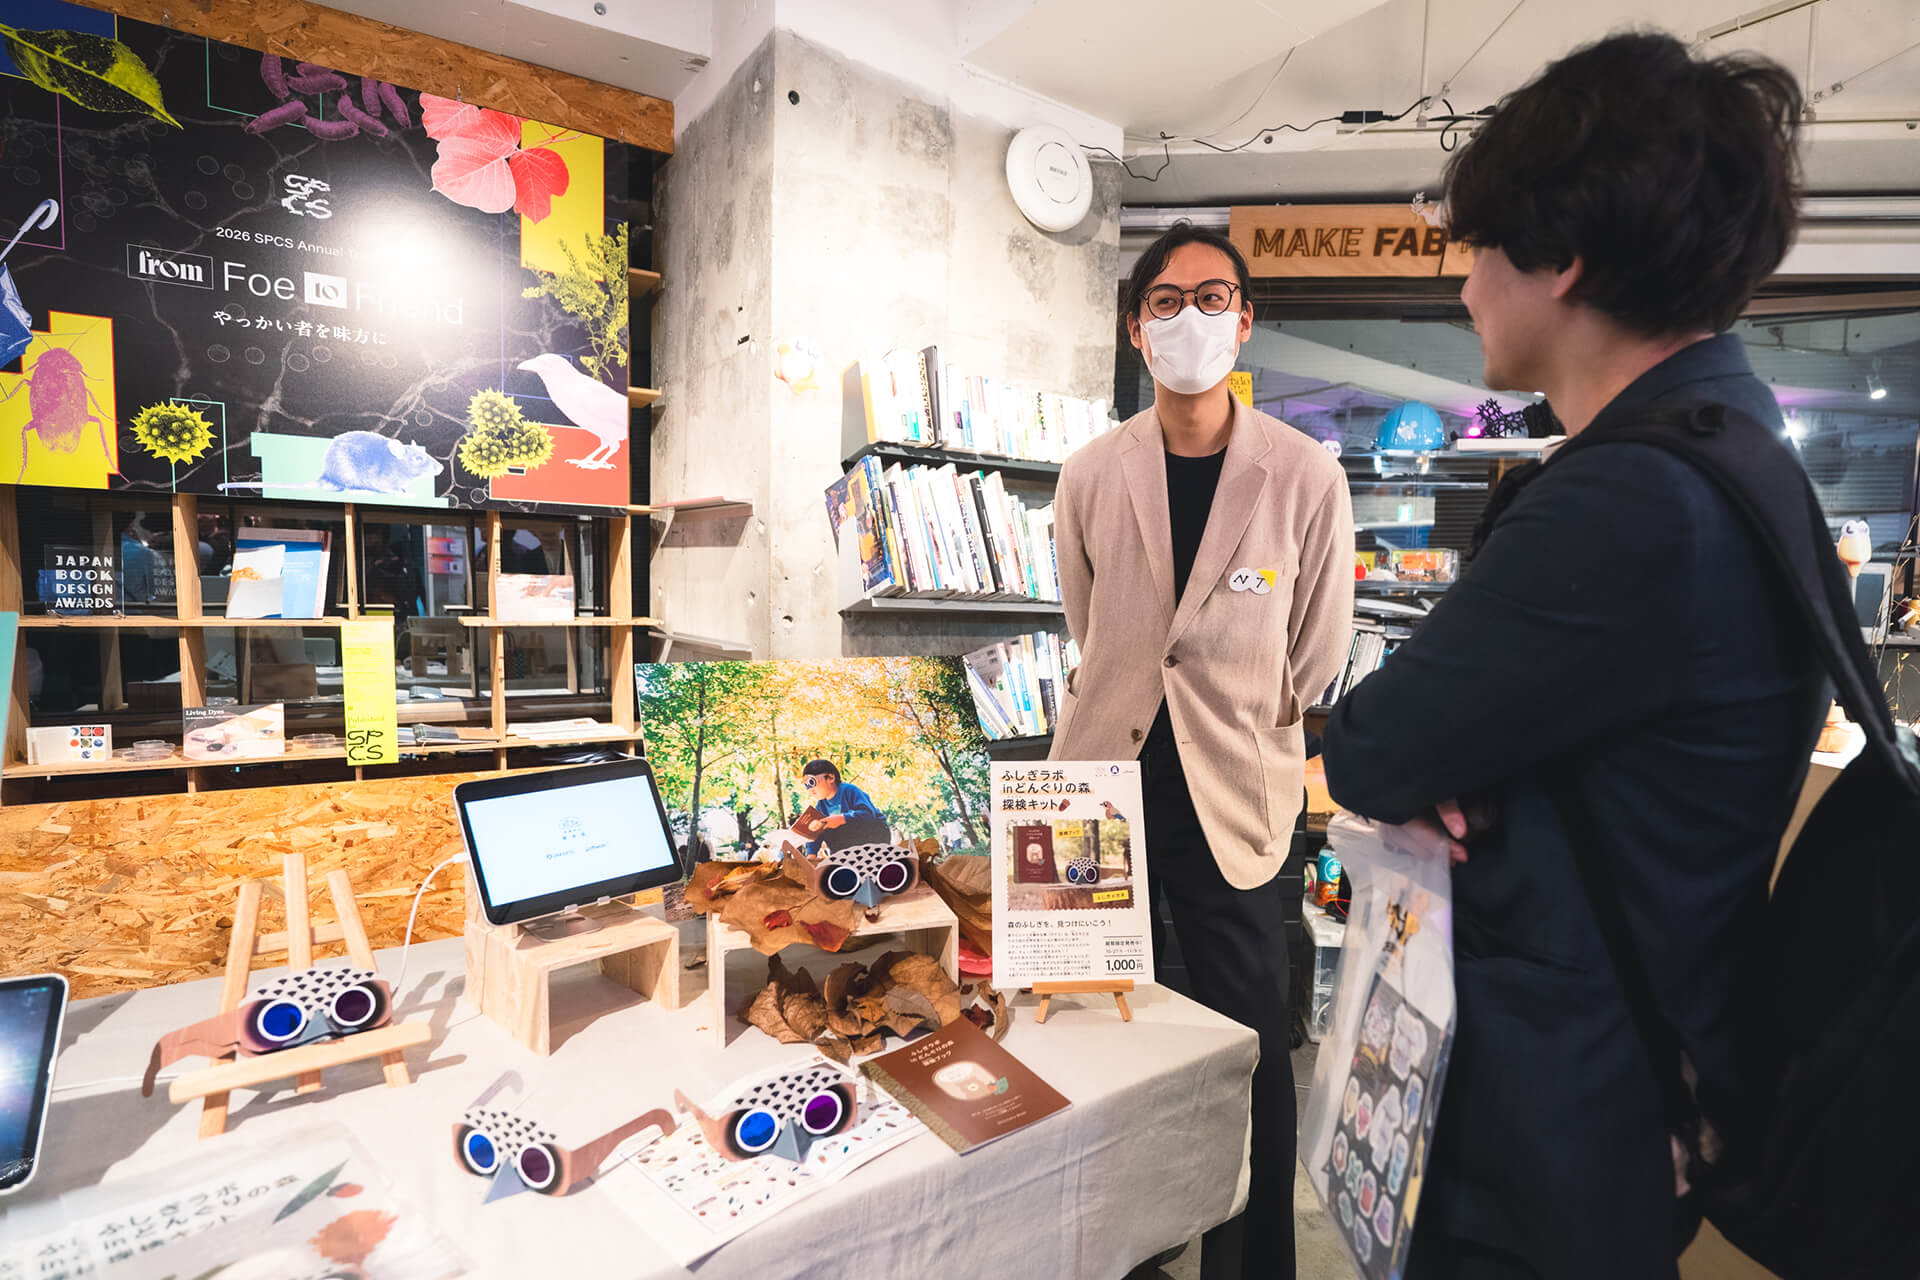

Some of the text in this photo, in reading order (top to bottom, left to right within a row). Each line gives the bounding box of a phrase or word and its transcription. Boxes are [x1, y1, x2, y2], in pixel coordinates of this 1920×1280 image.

[216, 226, 251, 242] 2026
[254, 233, 294, 249] SPCS
[297, 240, 344, 257] Annual
[1252, 227, 1364, 257] MAKE
[1373, 227, 1447, 257] FAB
[138, 250, 204, 283] from
[223, 261, 296, 300] Foe
[212, 310, 387, 345] やっかい者を味方に
[55, 554, 113, 567] JAPAN
[55, 569, 114, 581] BOOK
[55, 583, 113, 595] DESIGN
[55, 597, 114, 609] AWARDS
[185, 708, 207, 716] Living
[1002, 769, 1064, 781] ふしぎラボ
[1002, 798, 1058, 811] 探検キット
